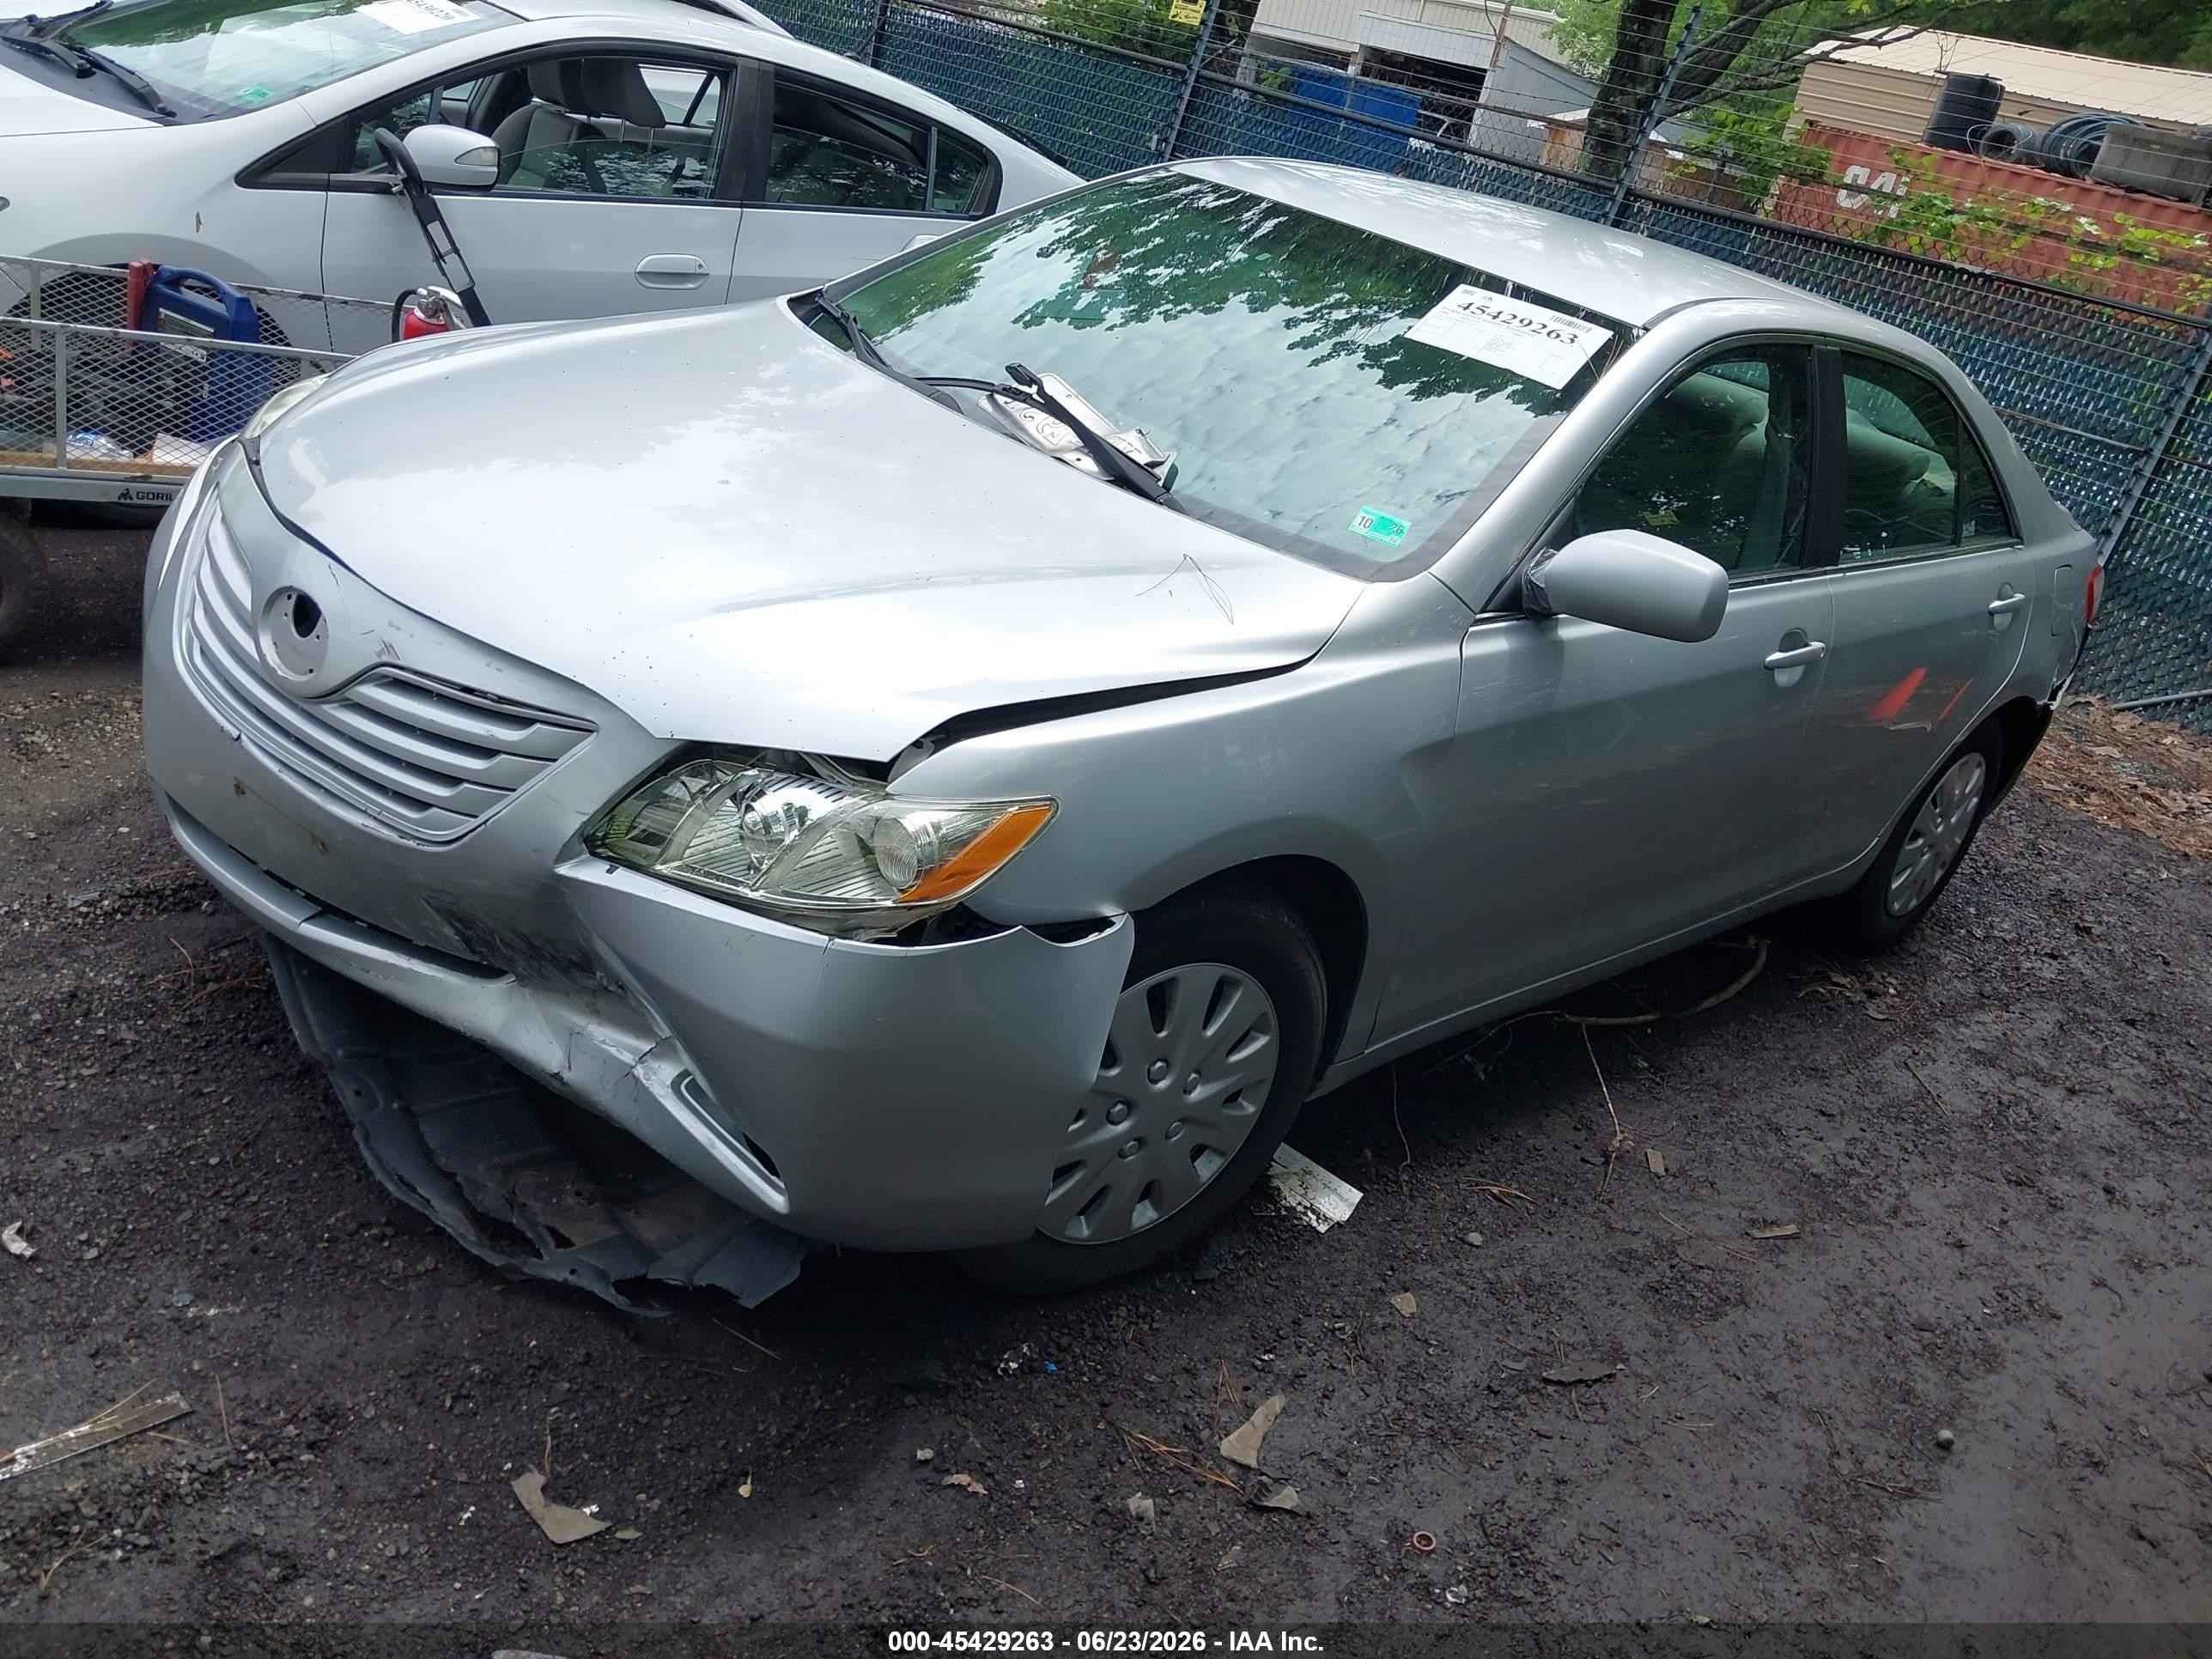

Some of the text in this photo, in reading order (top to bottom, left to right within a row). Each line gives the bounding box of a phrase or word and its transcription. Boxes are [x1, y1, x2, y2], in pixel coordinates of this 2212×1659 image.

[1456, 302, 1578, 345] 45429263
[1358, 515, 1405, 535] 10 26
